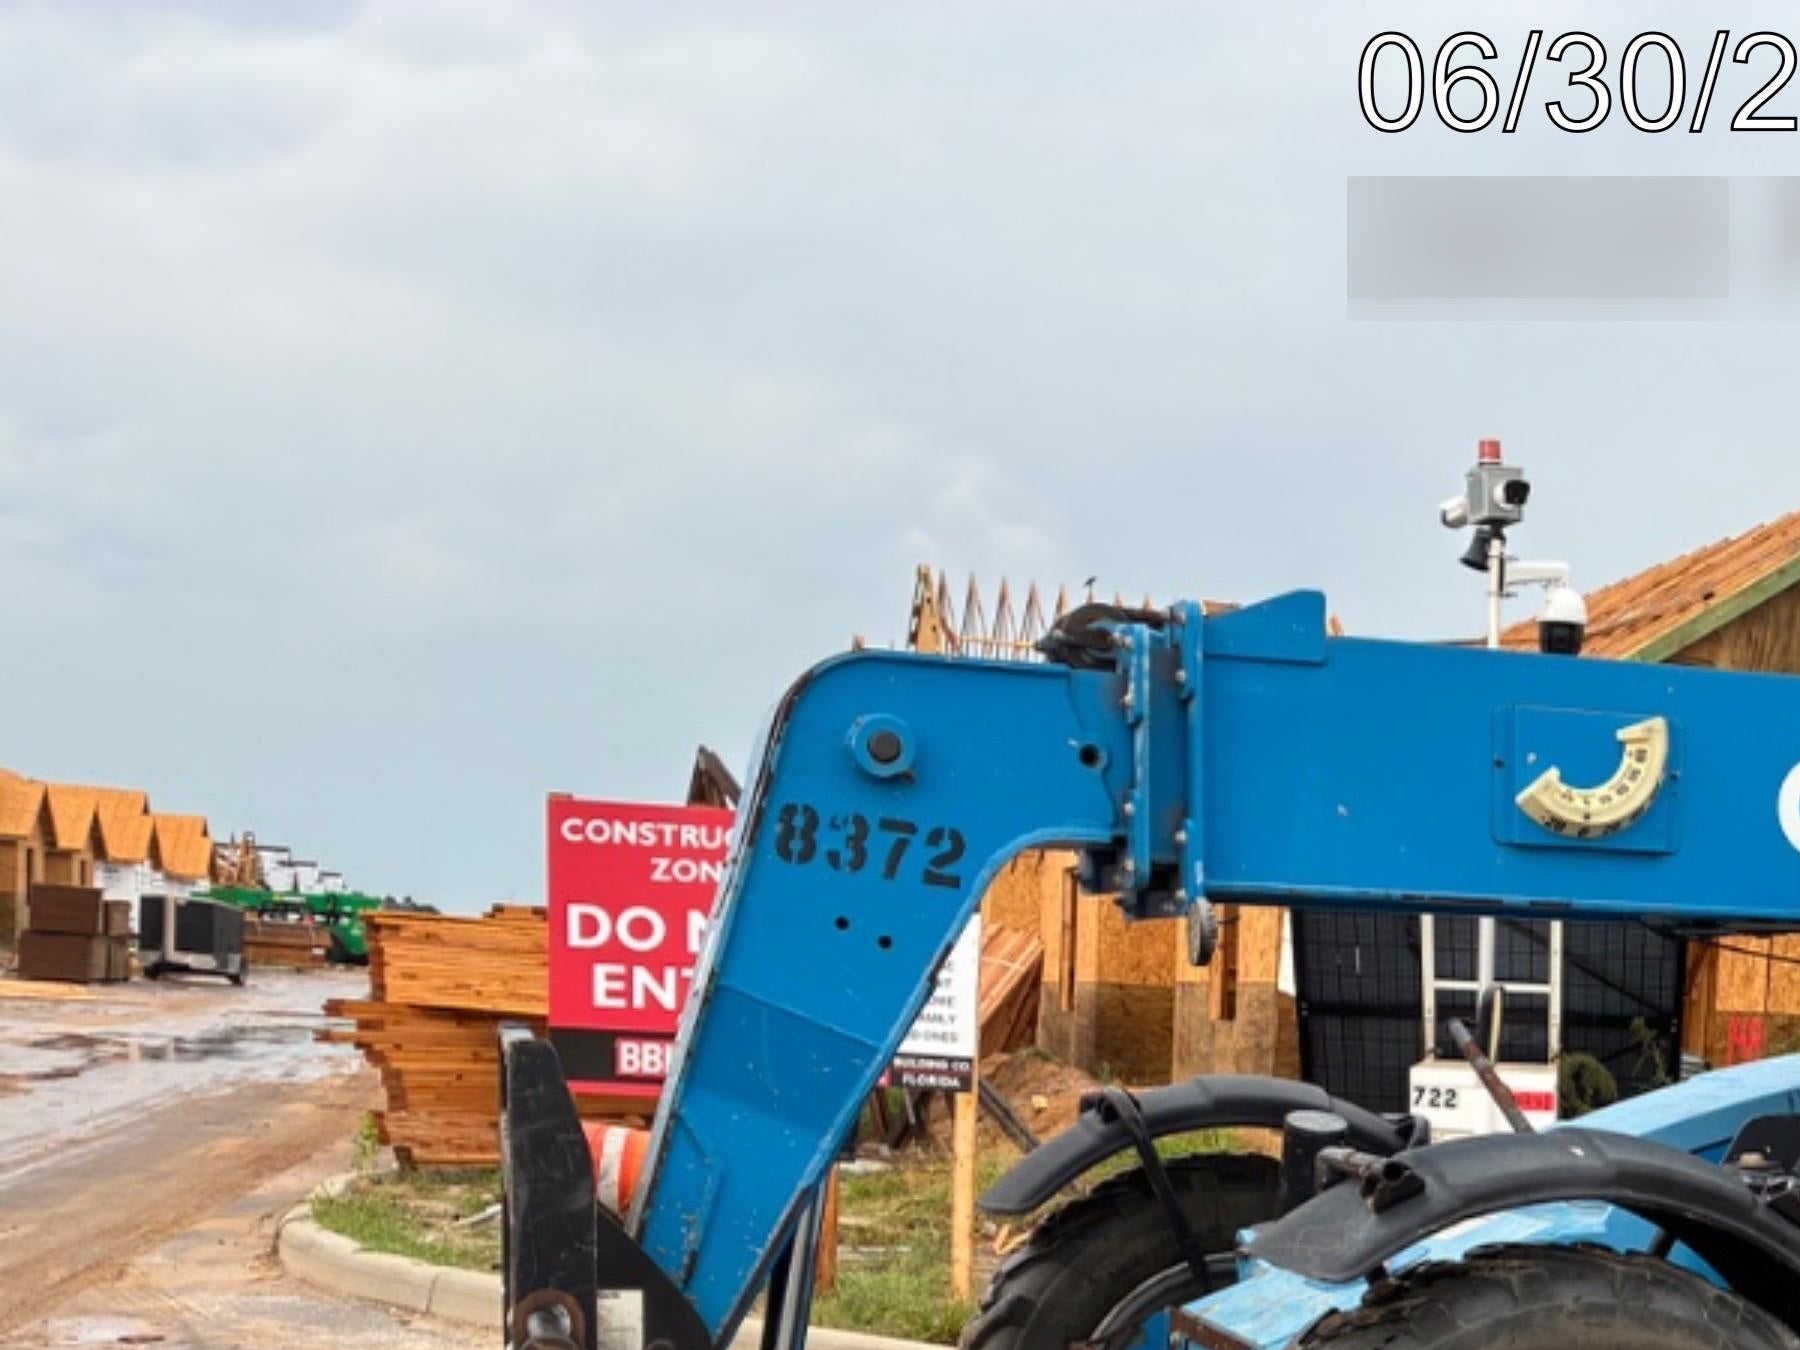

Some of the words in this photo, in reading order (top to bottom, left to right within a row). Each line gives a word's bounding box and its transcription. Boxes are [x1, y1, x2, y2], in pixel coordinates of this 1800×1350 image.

[776, 803, 966, 890] 8372
[566, 903, 666, 952] DO
[1413, 1086, 1457, 1109] 722
